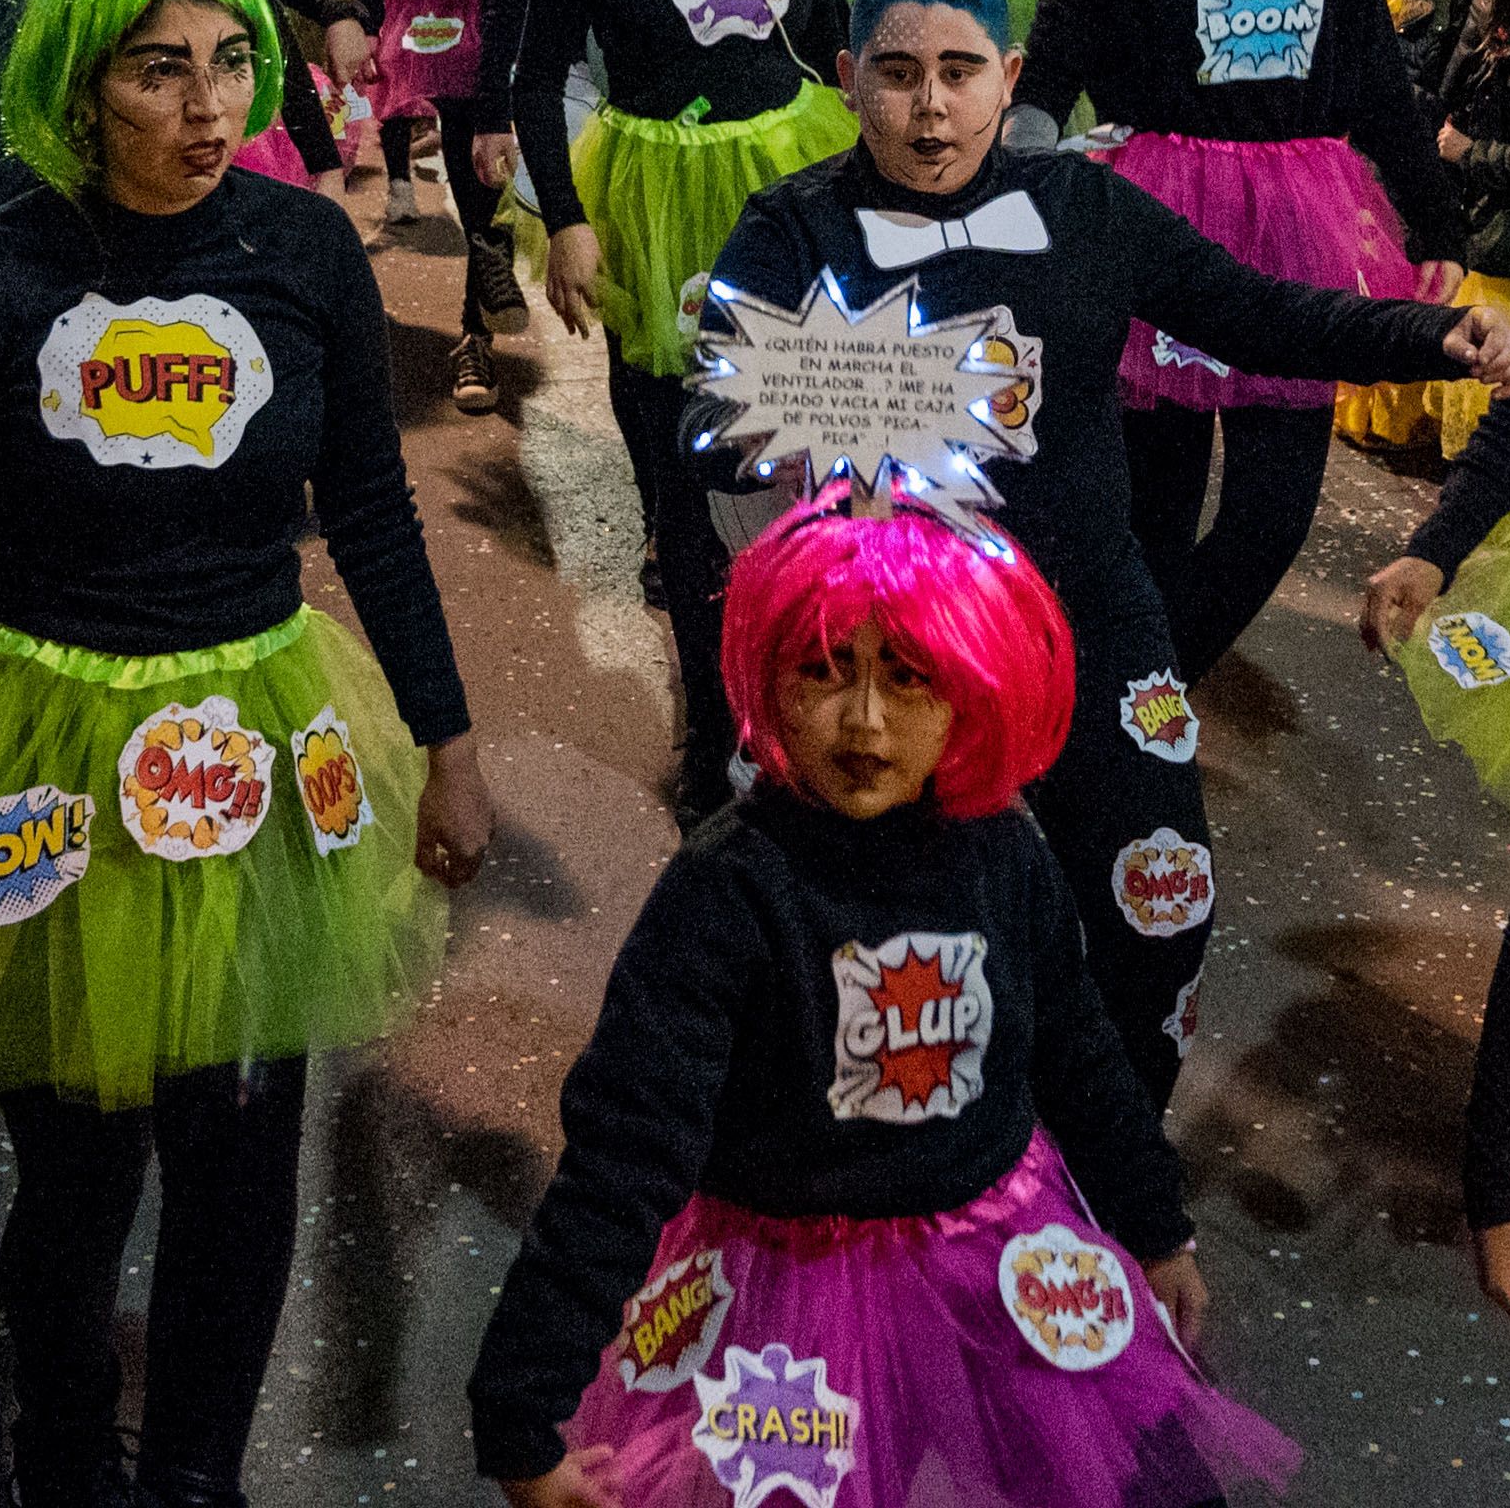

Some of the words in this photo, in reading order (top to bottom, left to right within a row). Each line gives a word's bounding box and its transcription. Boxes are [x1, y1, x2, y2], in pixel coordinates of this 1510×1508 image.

[1206, 3, 1316, 43] BOOM
[893, 342, 954, 360] PUESTO
[800, 356, 822, 371] EN
[829, 359, 893, 373] MARCHA
[900, 361, 918, 376] EL
[80, 353, 237, 409] PUFF!
[932, 382, 954, 395] HA
[759, 392, 823, 408] DEJADO
[886, 398, 906, 411] MI
[914, 399, 955, 414] CAJA
[783, 411, 803, 426] DE
[810, 412, 871, 429] POLVOS
[844, 994, 982, 1061] GLUP
[708, 1403, 853, 1450] CRASH!
